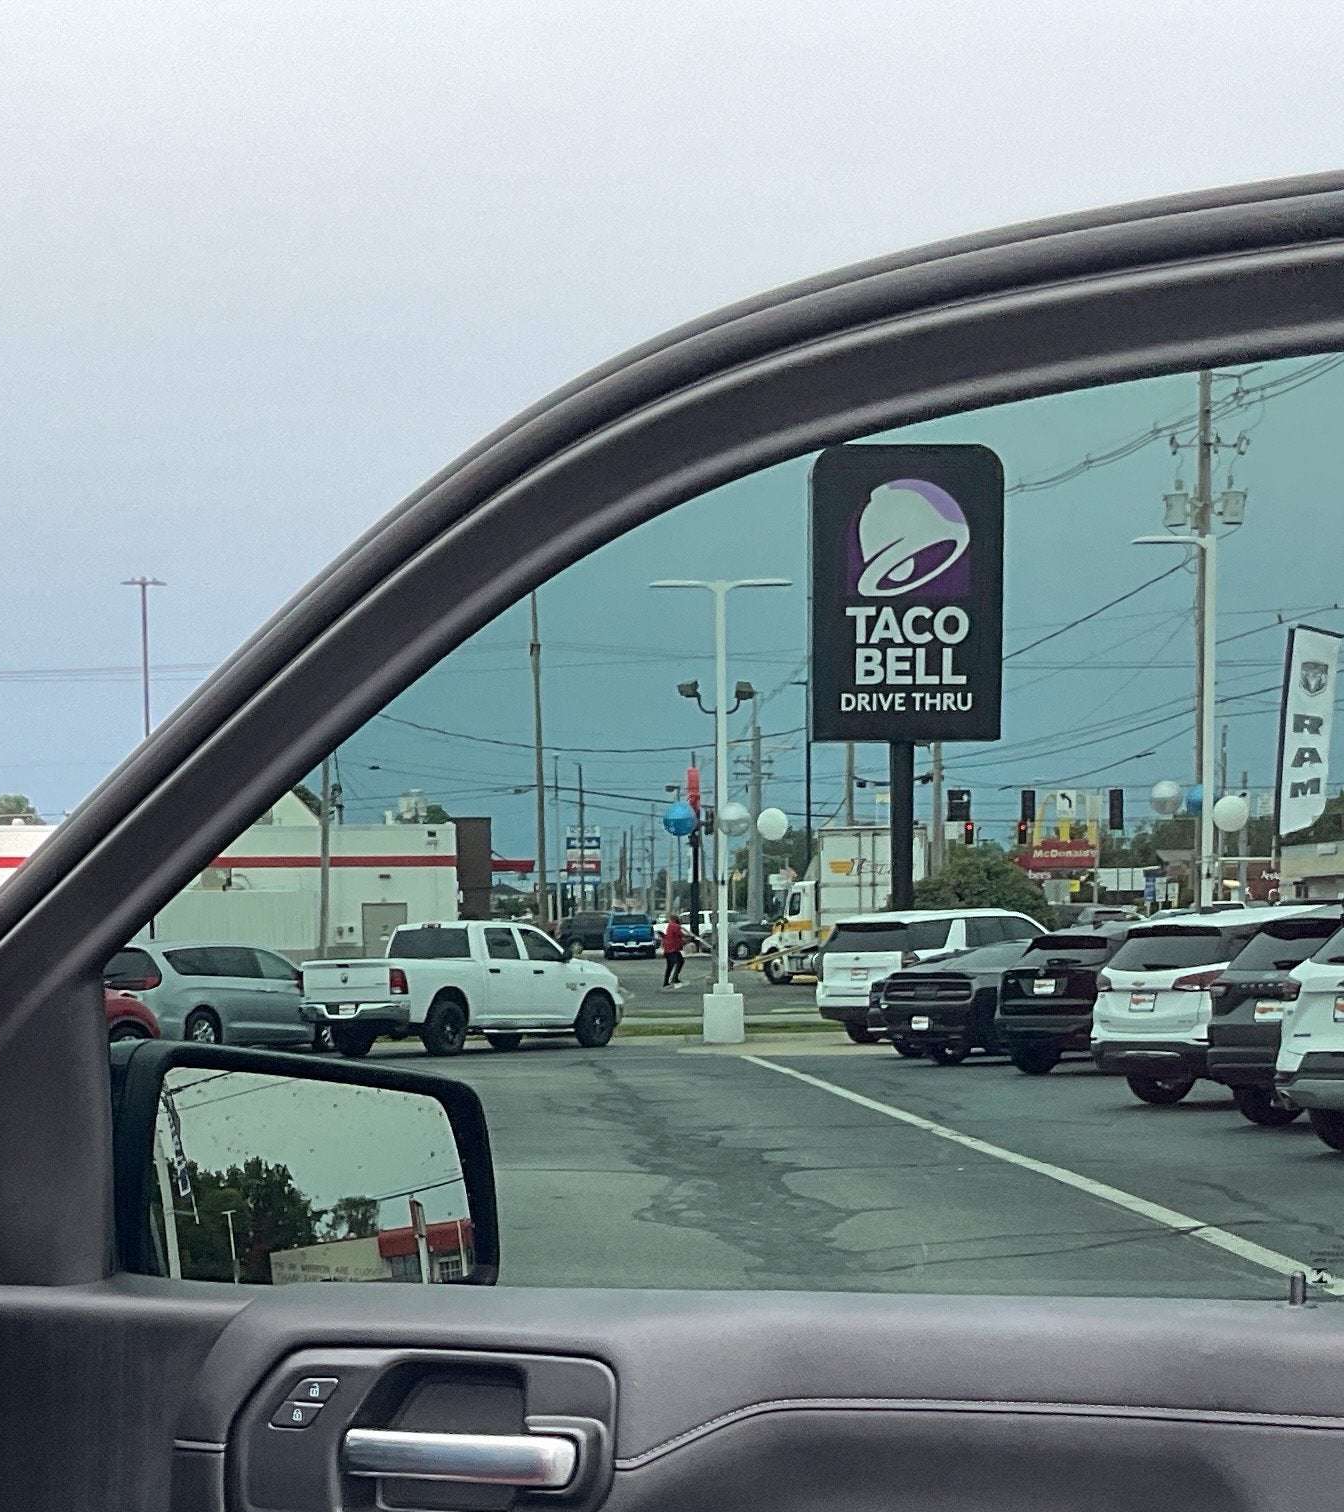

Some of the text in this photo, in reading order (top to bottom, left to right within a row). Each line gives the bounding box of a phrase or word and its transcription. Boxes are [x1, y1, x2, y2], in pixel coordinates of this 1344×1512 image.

[845, 606, 970, 644] TACO
[855, 647, 967, 686] BELL
[840, 691, 973, 712] DRIVE THRU
[1289, 713, 1324, 799] RAM
